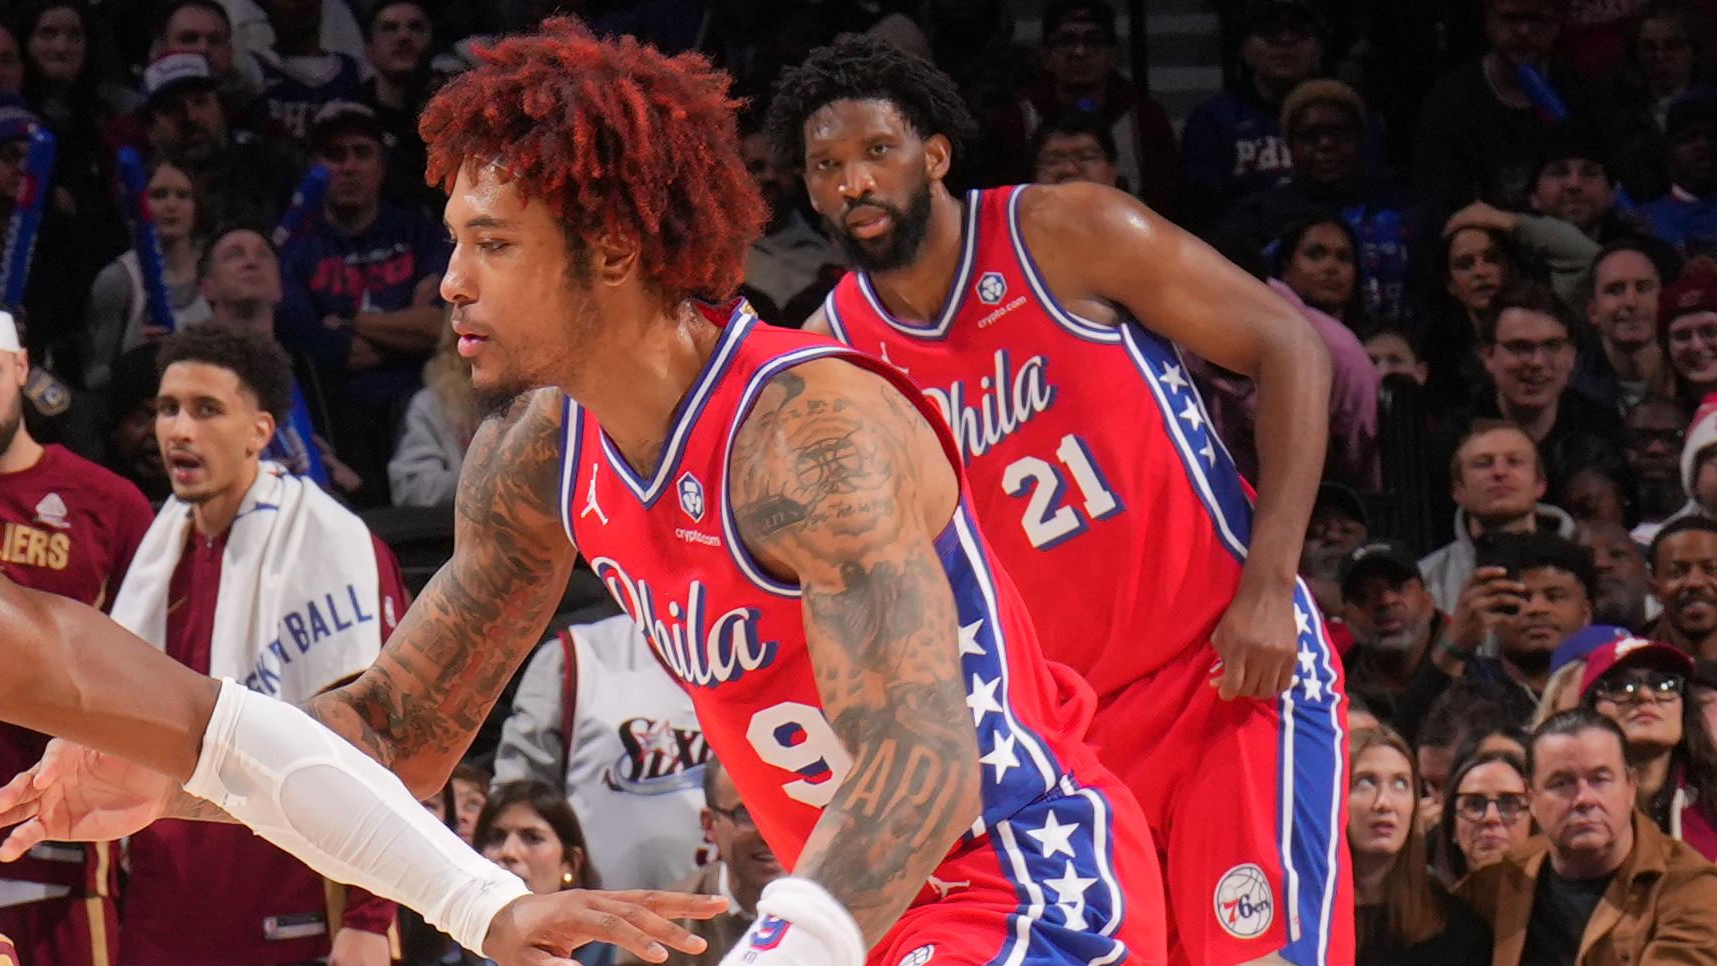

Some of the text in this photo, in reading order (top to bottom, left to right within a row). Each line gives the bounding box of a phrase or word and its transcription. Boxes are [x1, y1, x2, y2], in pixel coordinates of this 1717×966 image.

[977, 295, 1027, 329] crypto.com
[1001, 433, 1127, 552] 21
[591, 556, 779, 688] Phila
[745, 701, 854, 809] 9
